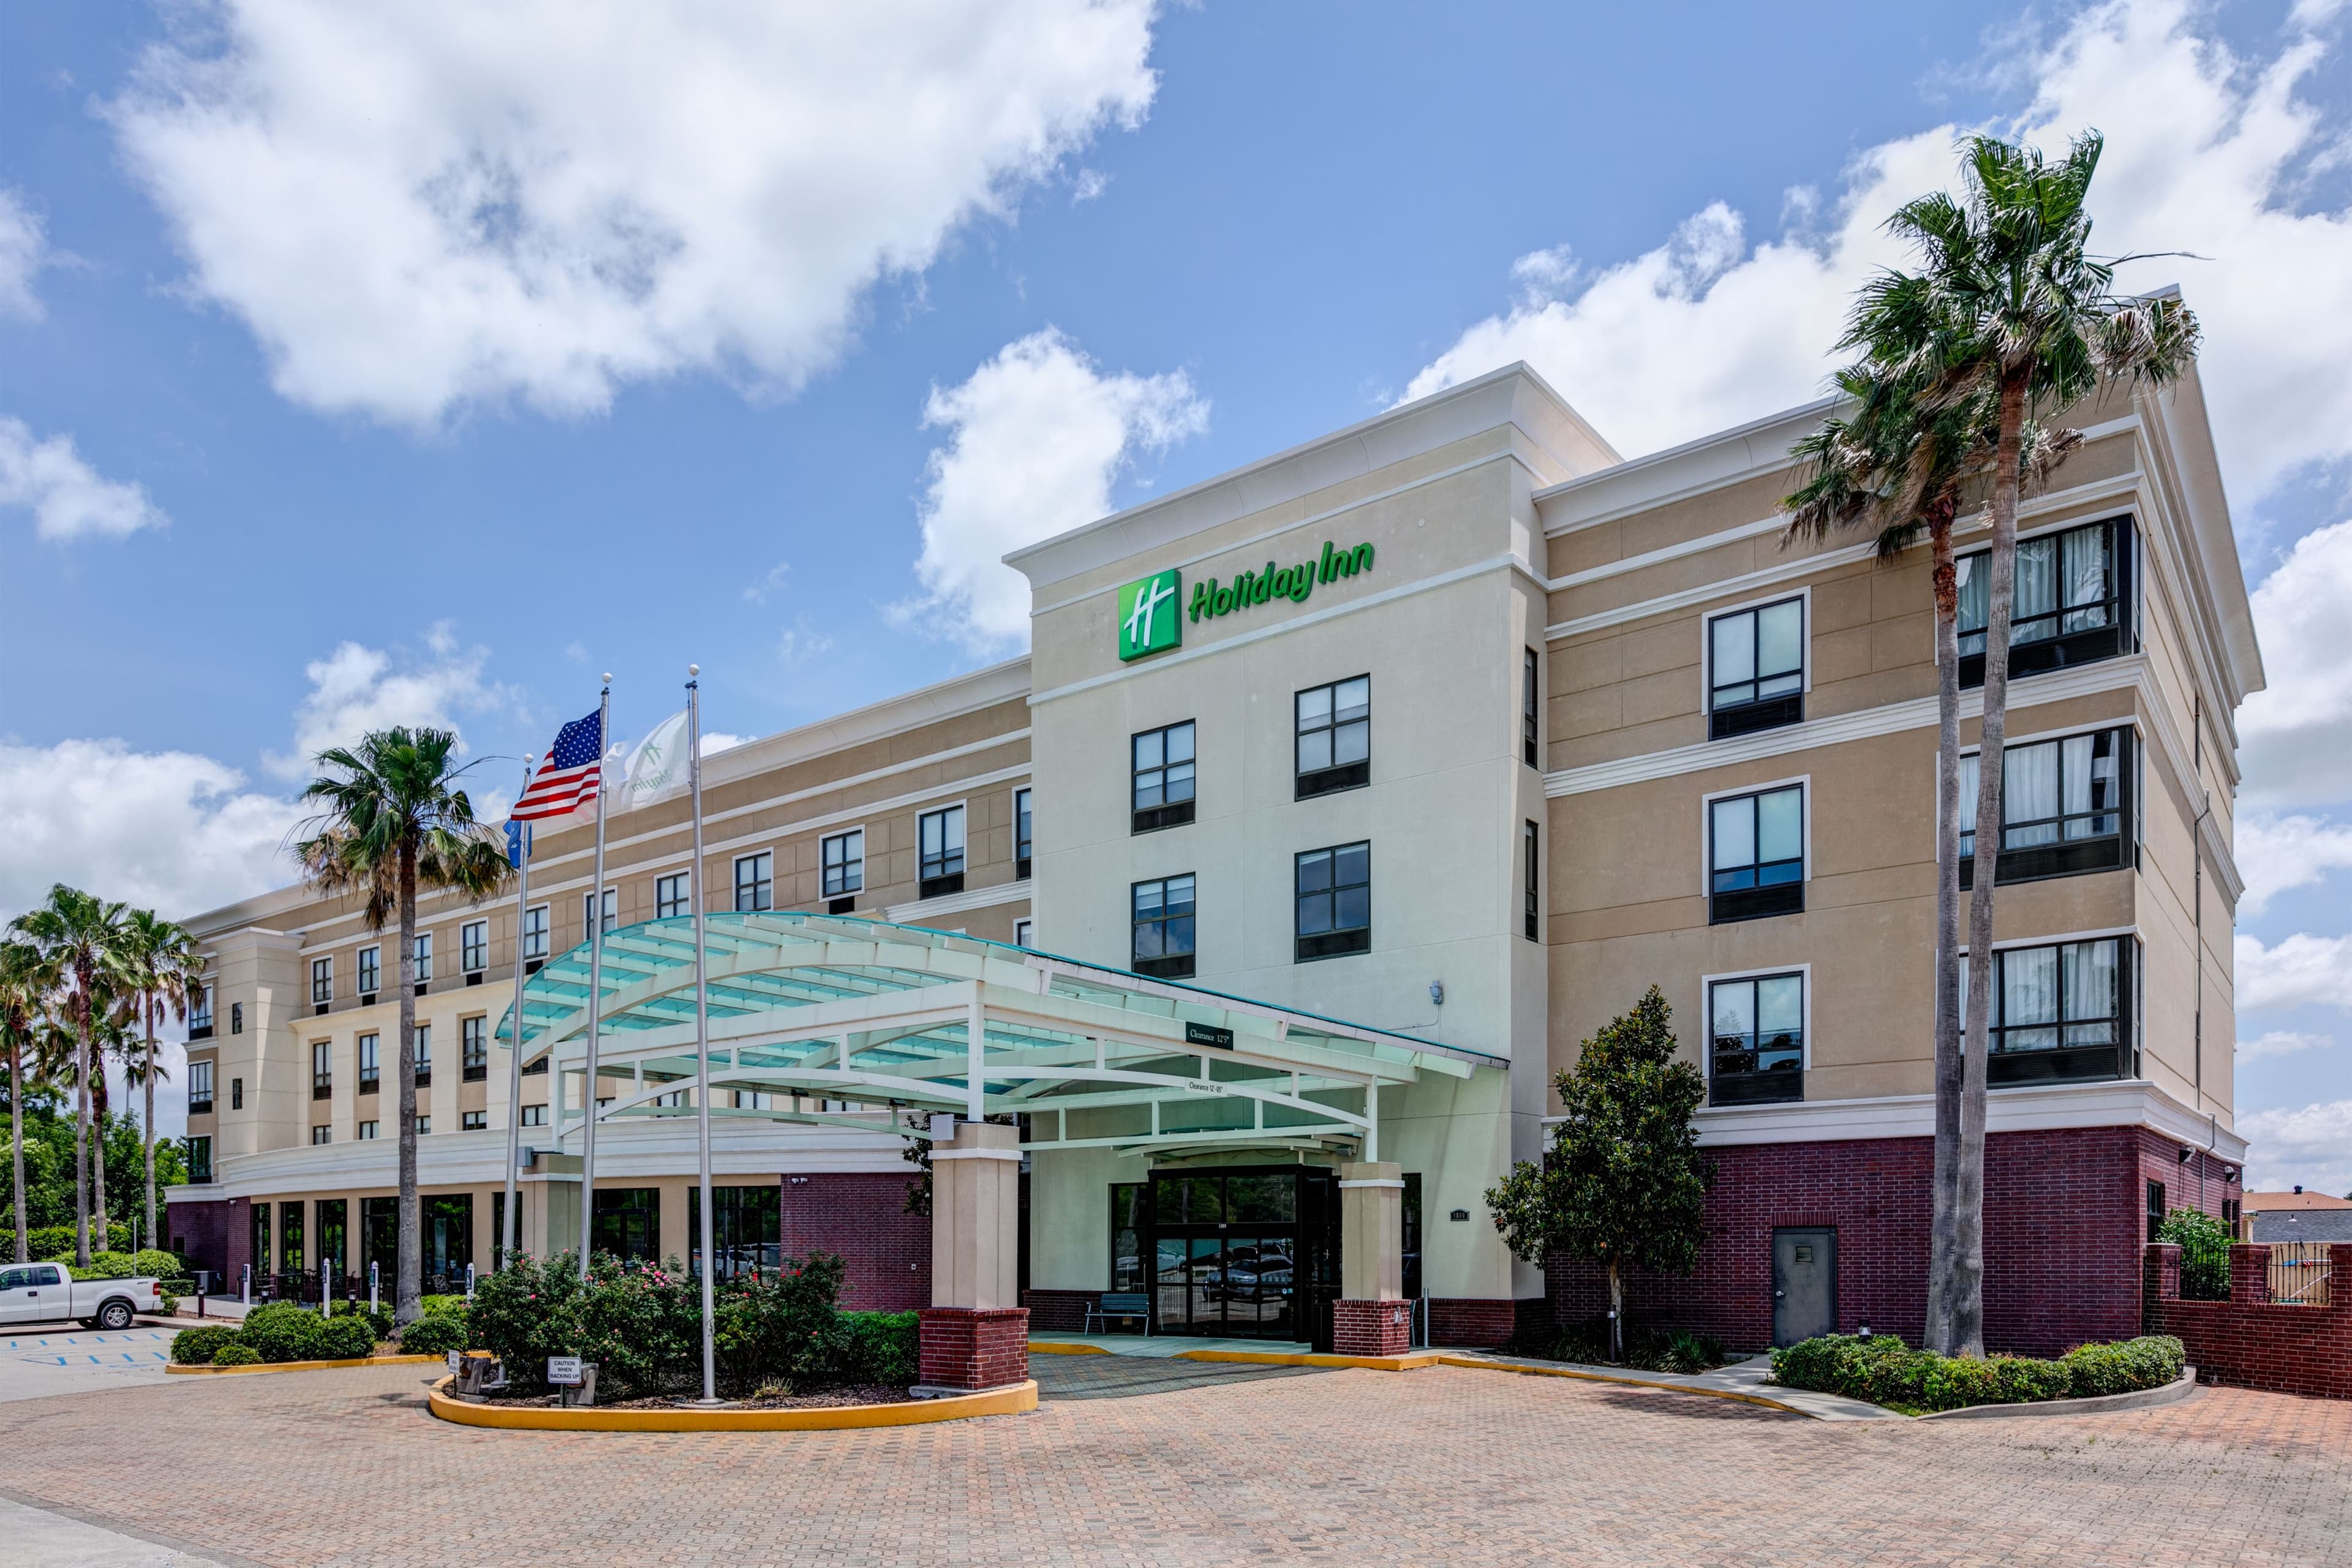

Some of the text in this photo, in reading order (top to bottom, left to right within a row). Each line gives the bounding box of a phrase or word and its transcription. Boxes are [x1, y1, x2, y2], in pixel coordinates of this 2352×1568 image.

[1188, 540, 1374, 624] Holiday Inn
[1190, 1028, 1215, 1041] Clearance
[1189, 1082, 1209, 1091] Clearance
